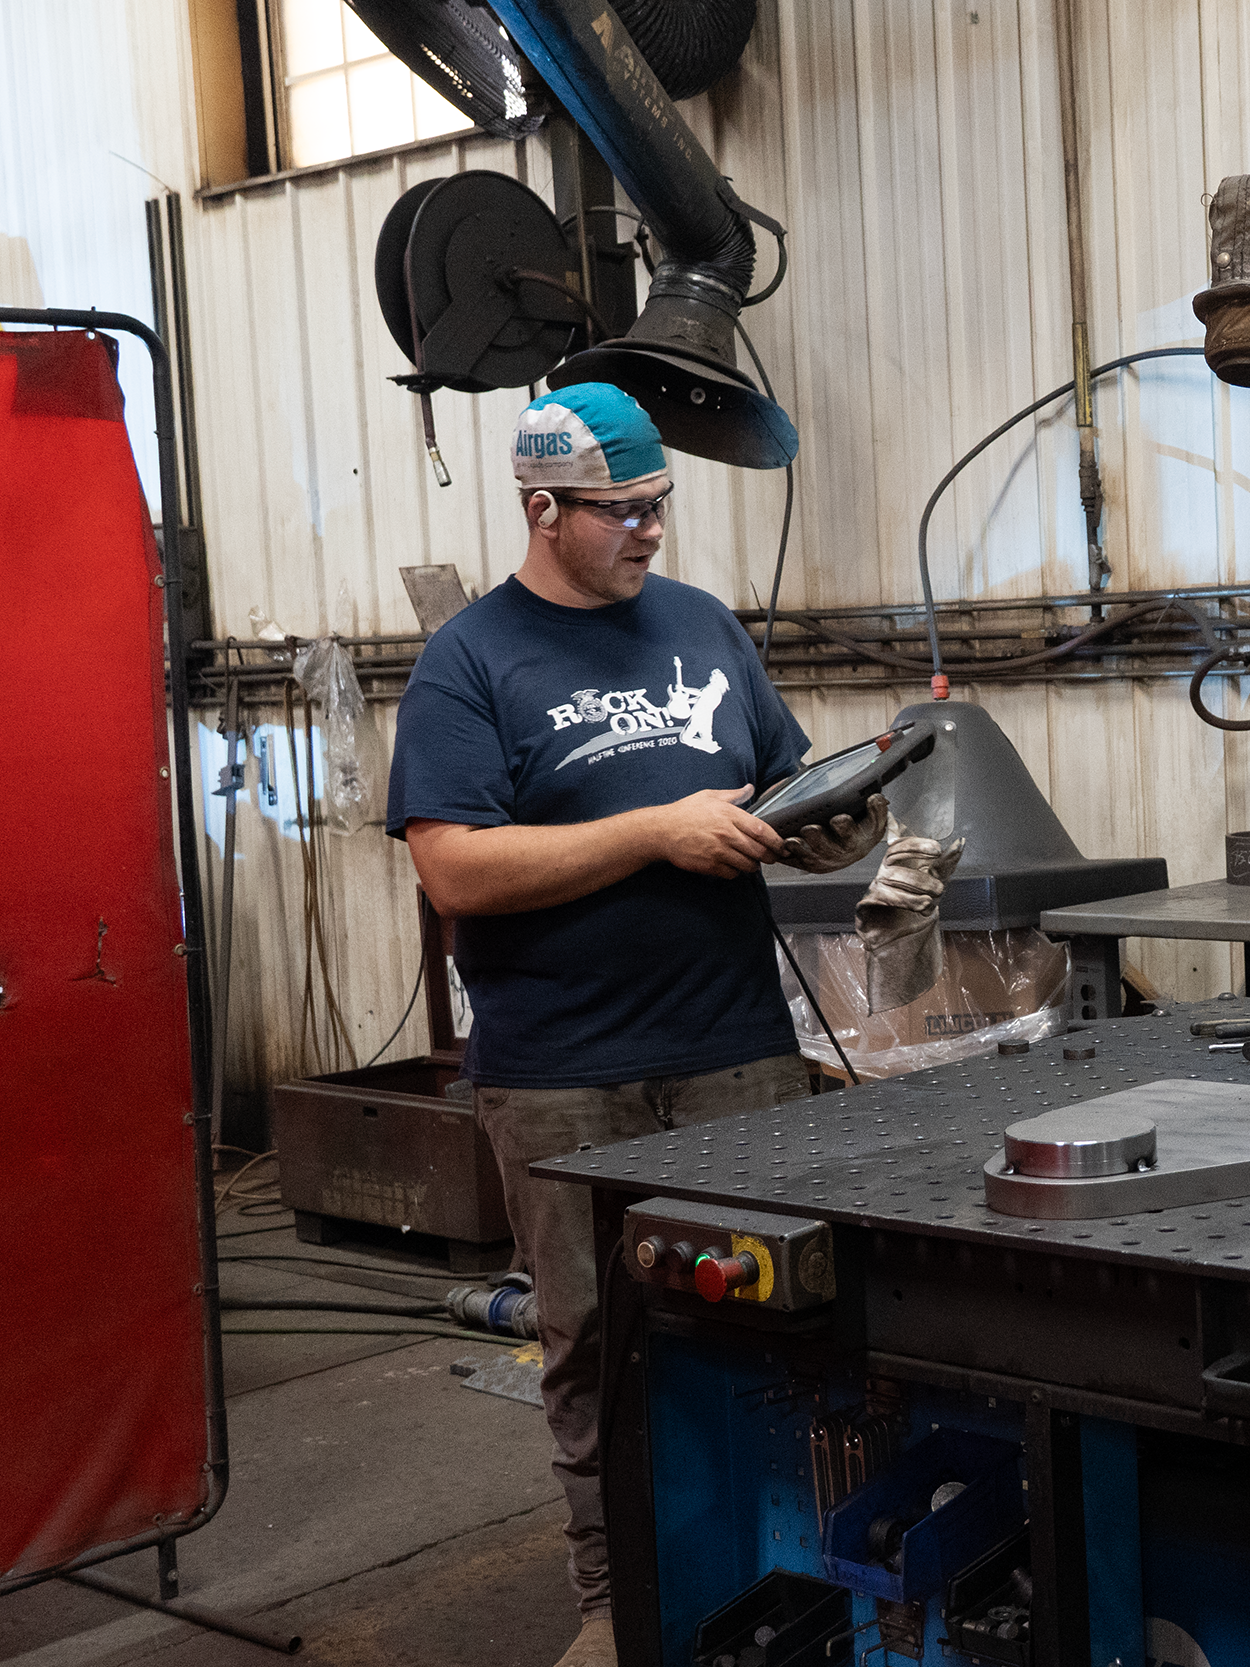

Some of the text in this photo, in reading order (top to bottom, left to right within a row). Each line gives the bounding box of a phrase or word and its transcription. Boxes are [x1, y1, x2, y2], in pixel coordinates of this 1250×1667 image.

[516, 430, 572, 459] Airgas
[610, 707, 674, 735] ON!
[617, 740, 656, 753] CONFERENCE
[657, 737, 678, 747] 2020
